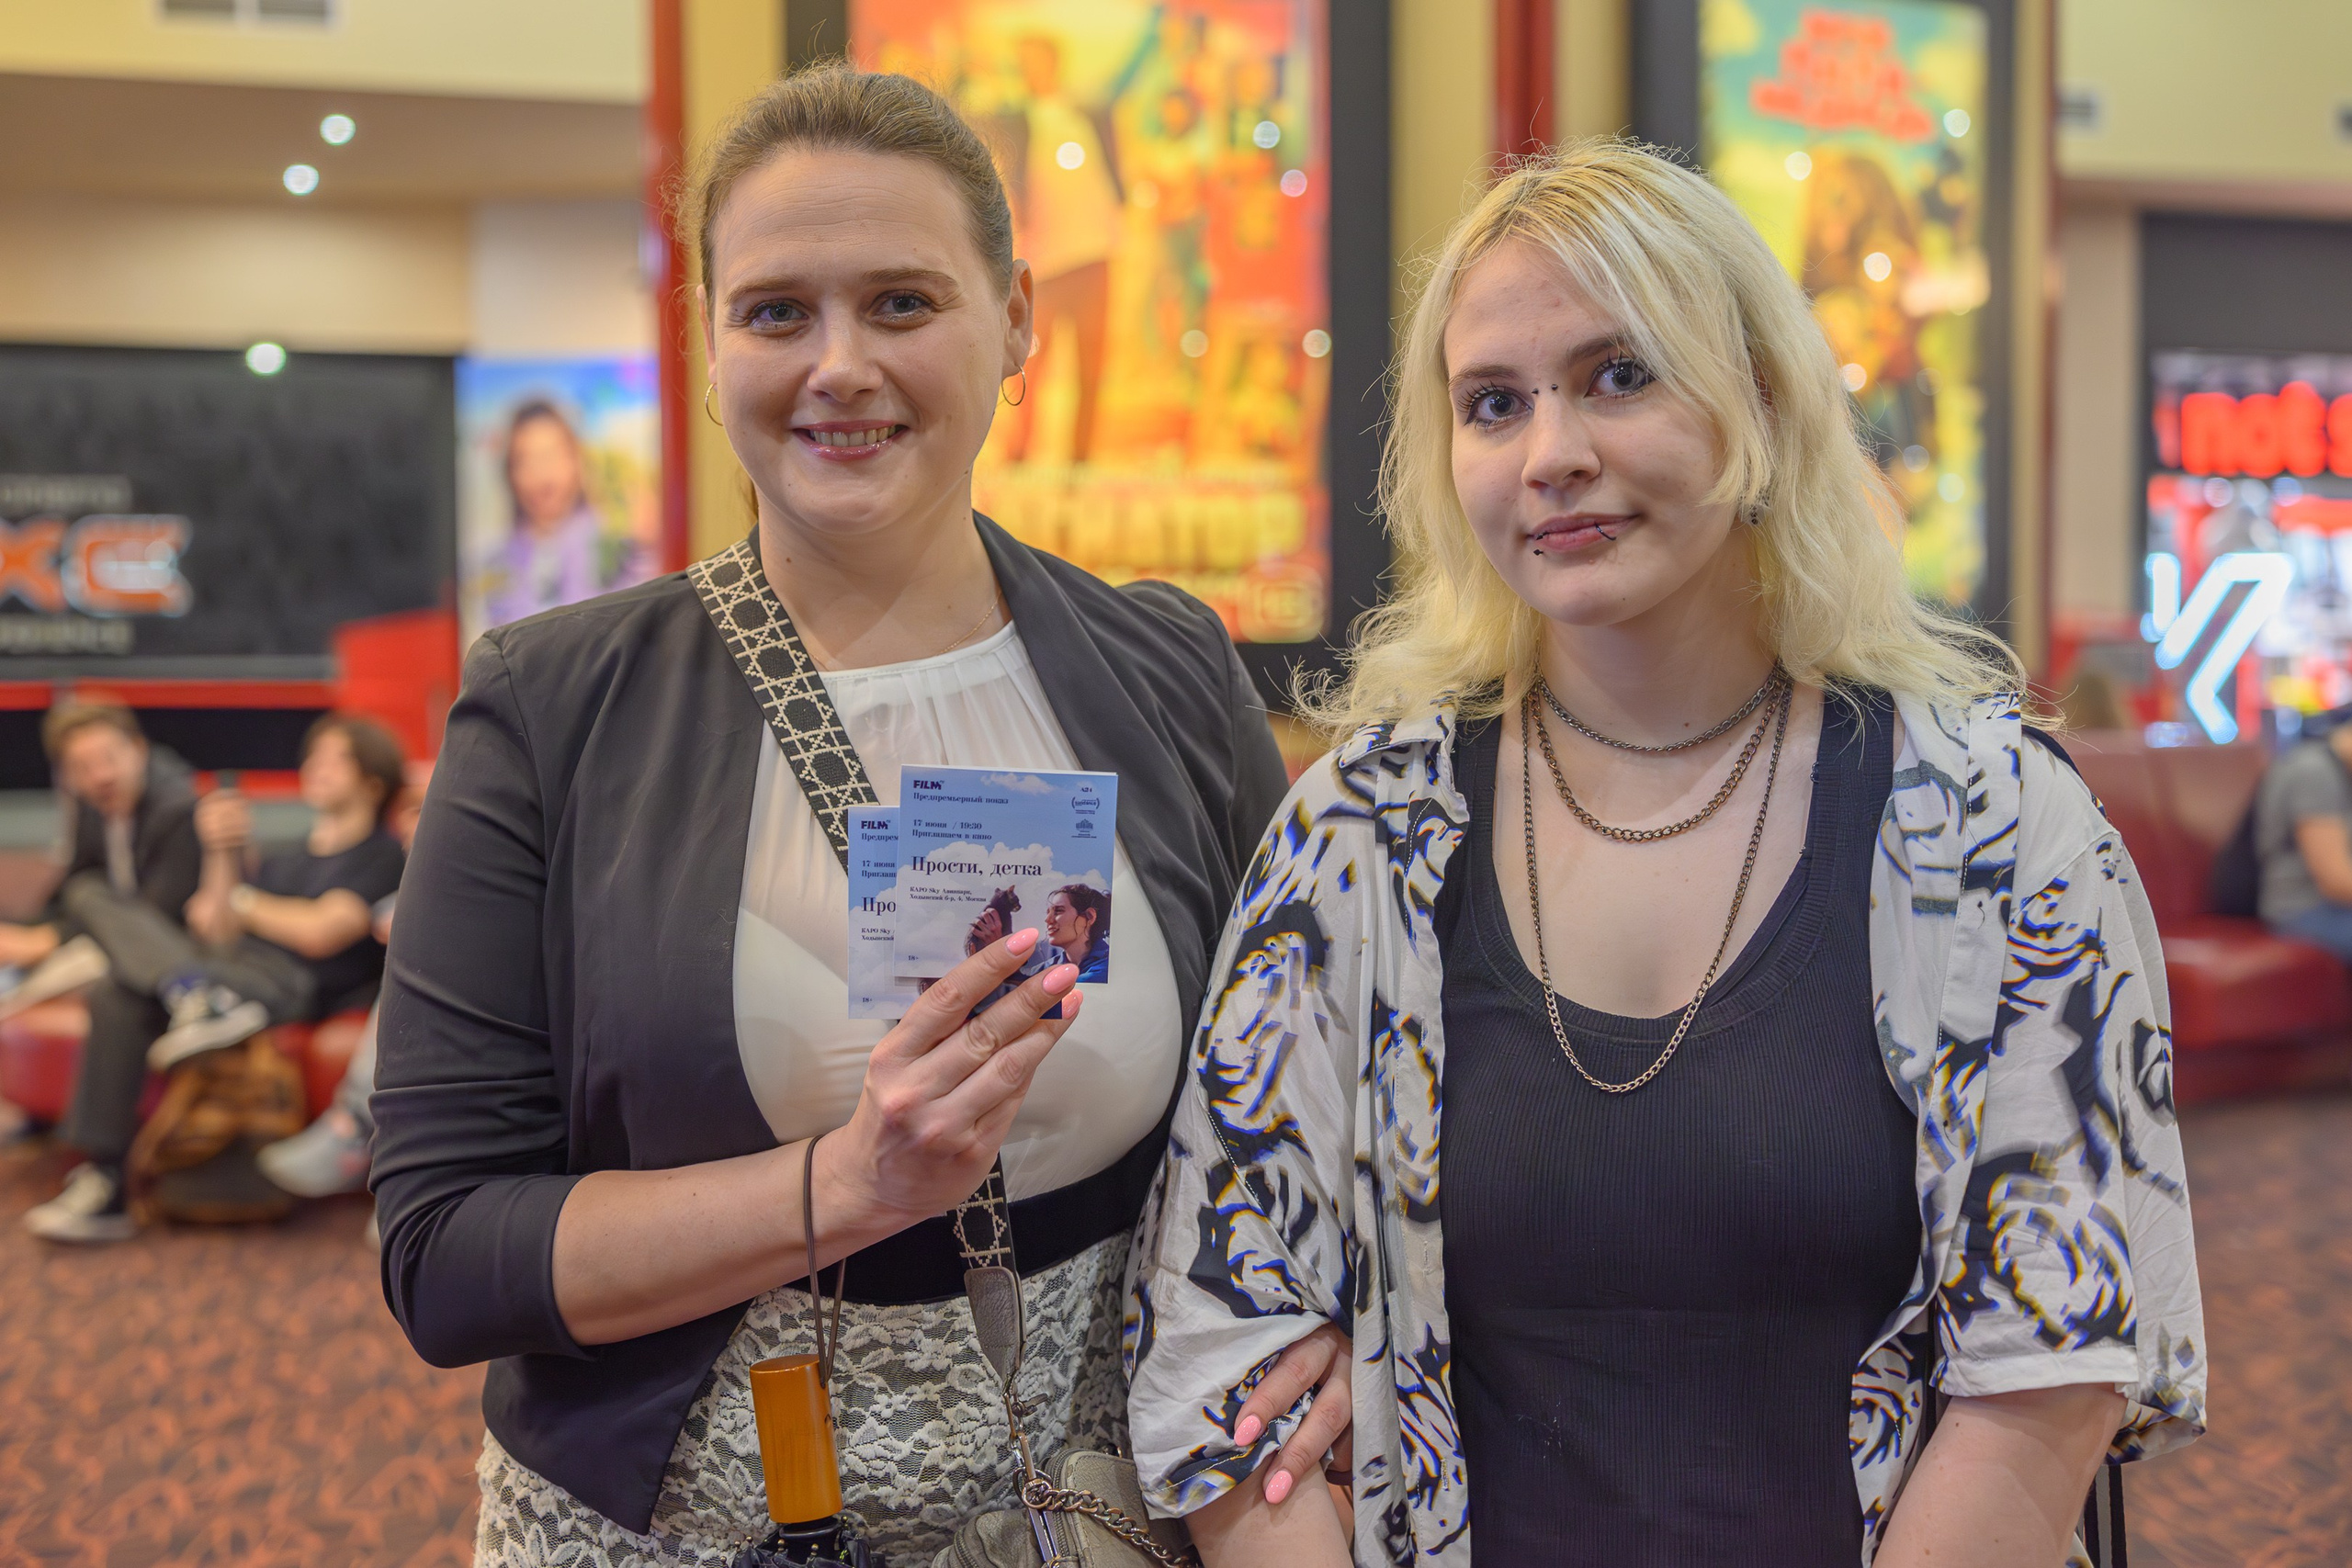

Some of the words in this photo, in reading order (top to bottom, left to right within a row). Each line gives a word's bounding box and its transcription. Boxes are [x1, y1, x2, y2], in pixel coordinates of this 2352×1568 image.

[913, 780, 942, 790] FILM
[913, 793, 983, 804] Предпремьерный
[861, 820, 888, 829] FILM
[960, 821, 982, 829] 19:30
[912, 829, 962, 839] Приглашаем
[910, 855, 983, 875] Прости,
[989, 862, 1043, 877] детка
[861, 897, 897, 916] Про
